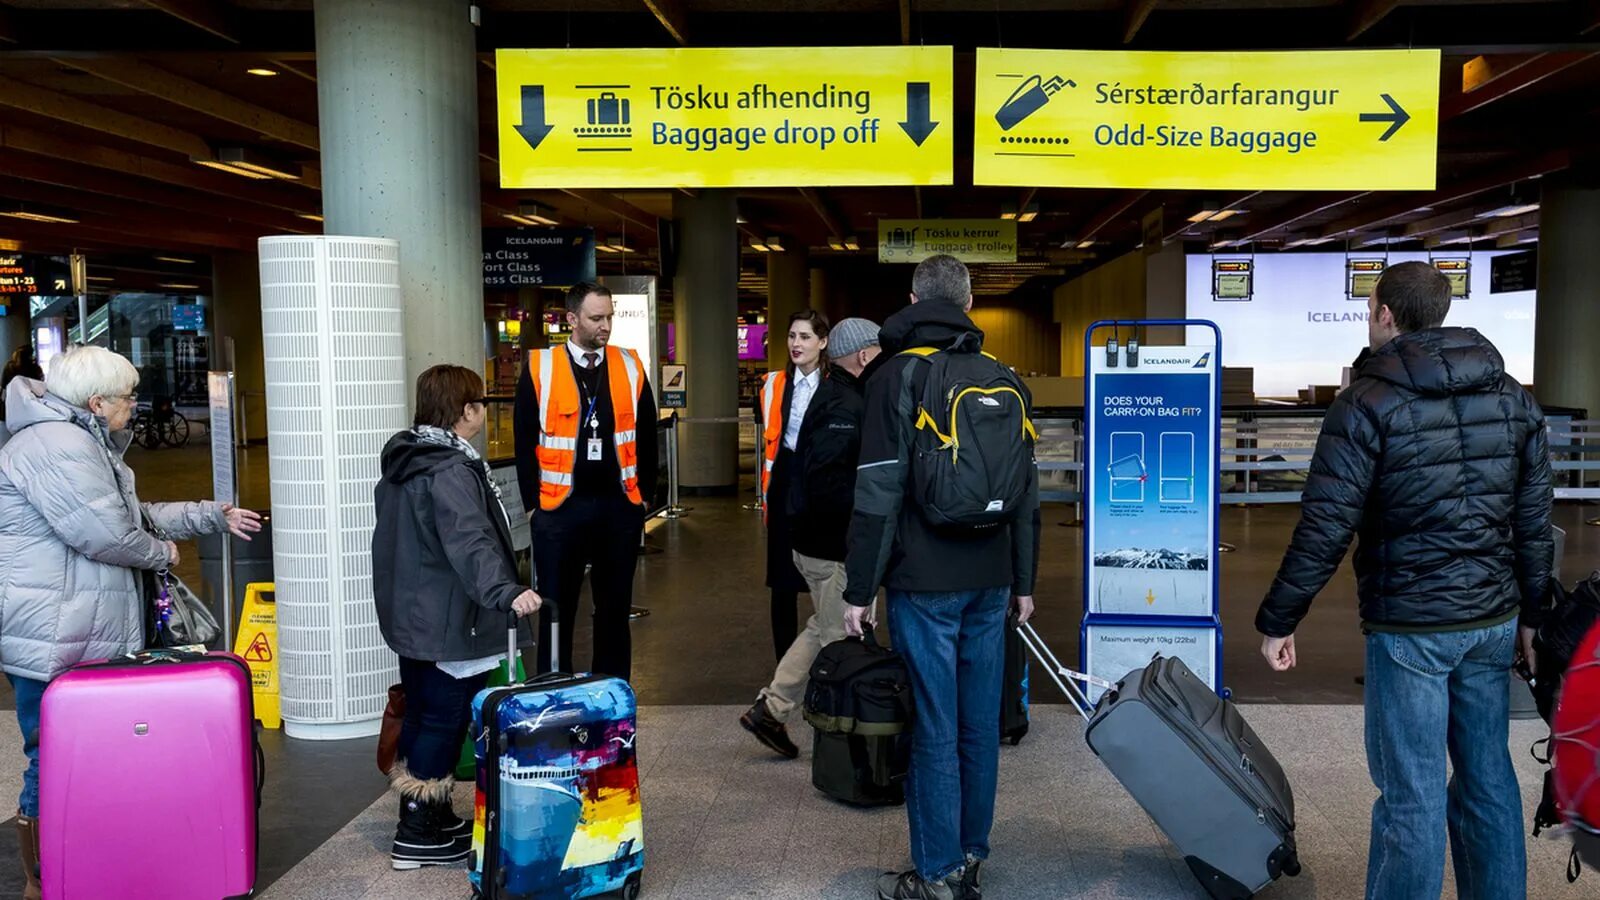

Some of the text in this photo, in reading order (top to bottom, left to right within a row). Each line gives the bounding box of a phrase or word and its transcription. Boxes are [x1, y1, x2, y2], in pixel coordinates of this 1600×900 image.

[650, 83, 870, 115] Tösku afhending
[1095, 82, 1340, 111] Sérstærðarfarangur
[652, 118, 881, 151] Baggage drop off
[1094, 123, 1317, 154] Odd-Size Baggage
[963, 227, 1000, 238] kerrur
[505, 236, 563, 245] ICELANDAIR
[924, 241, 1013, 254] Luggage trolley
[495, 250, 529, 260] Class
[506, 261, 541, 272] Class
[24, 277, 34, 285] 23
[509, 274, 543, 284] Class
[1104, 396, 1164, 406] DOES YOUR
[1104, 407, 1202, 417] CARRY-ON BAG FIT?
[1100, 635, 1131, 644] Maximum
[1133, 635, 1155, 645] weight
[1156, 635, 1173, 645] 10kg
